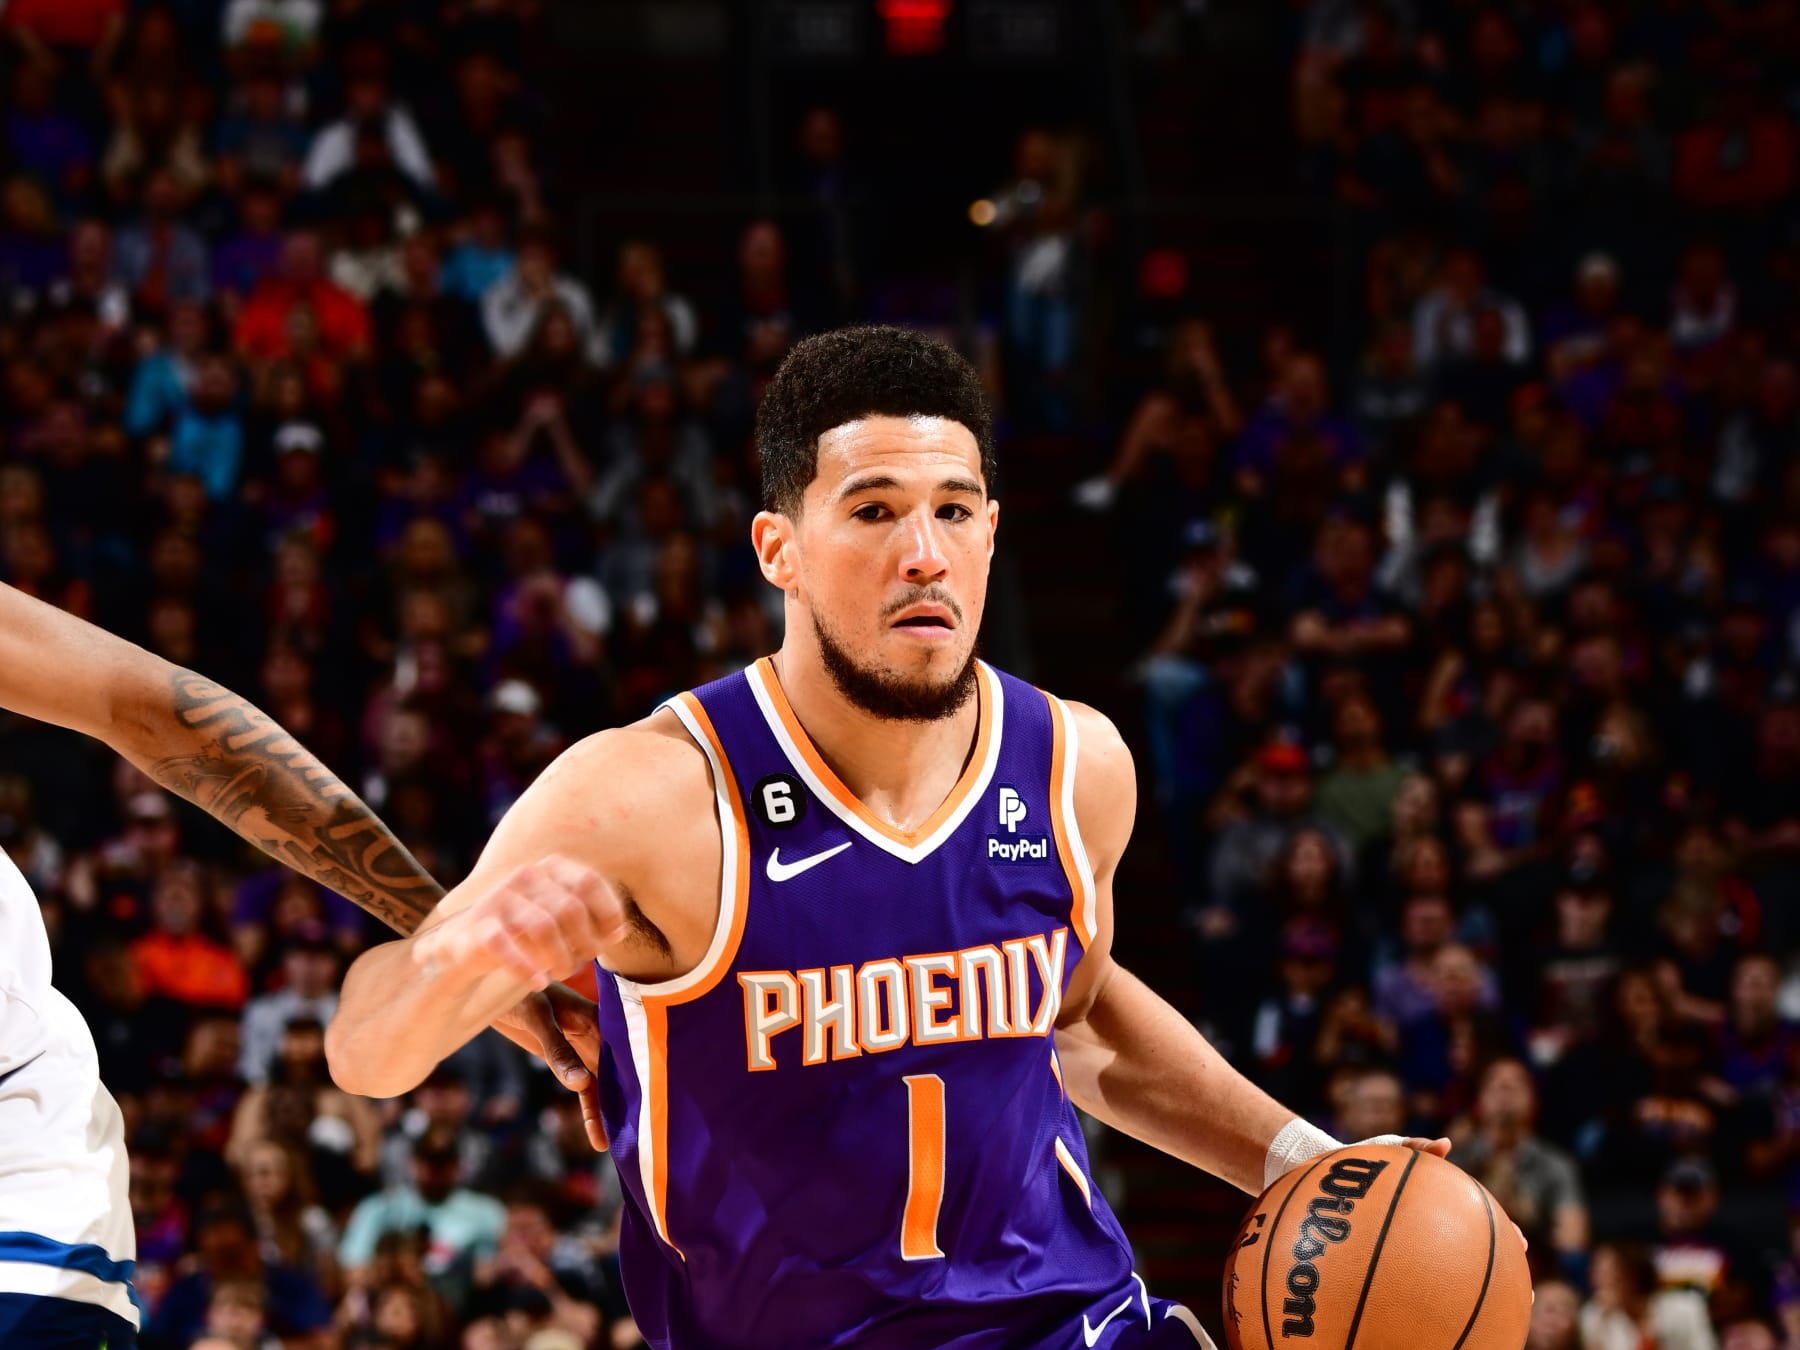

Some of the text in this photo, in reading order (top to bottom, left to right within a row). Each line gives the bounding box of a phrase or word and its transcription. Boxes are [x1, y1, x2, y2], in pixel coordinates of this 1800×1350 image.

[762, 781, 796, 823] 6
[988, 838, 1047, 861] PayPal
[737, 927, 1068, 1072] PHOENIX
[901, 1074, 946, 1261] 1
[1282, 1158, 1390, 1338] Wilson
